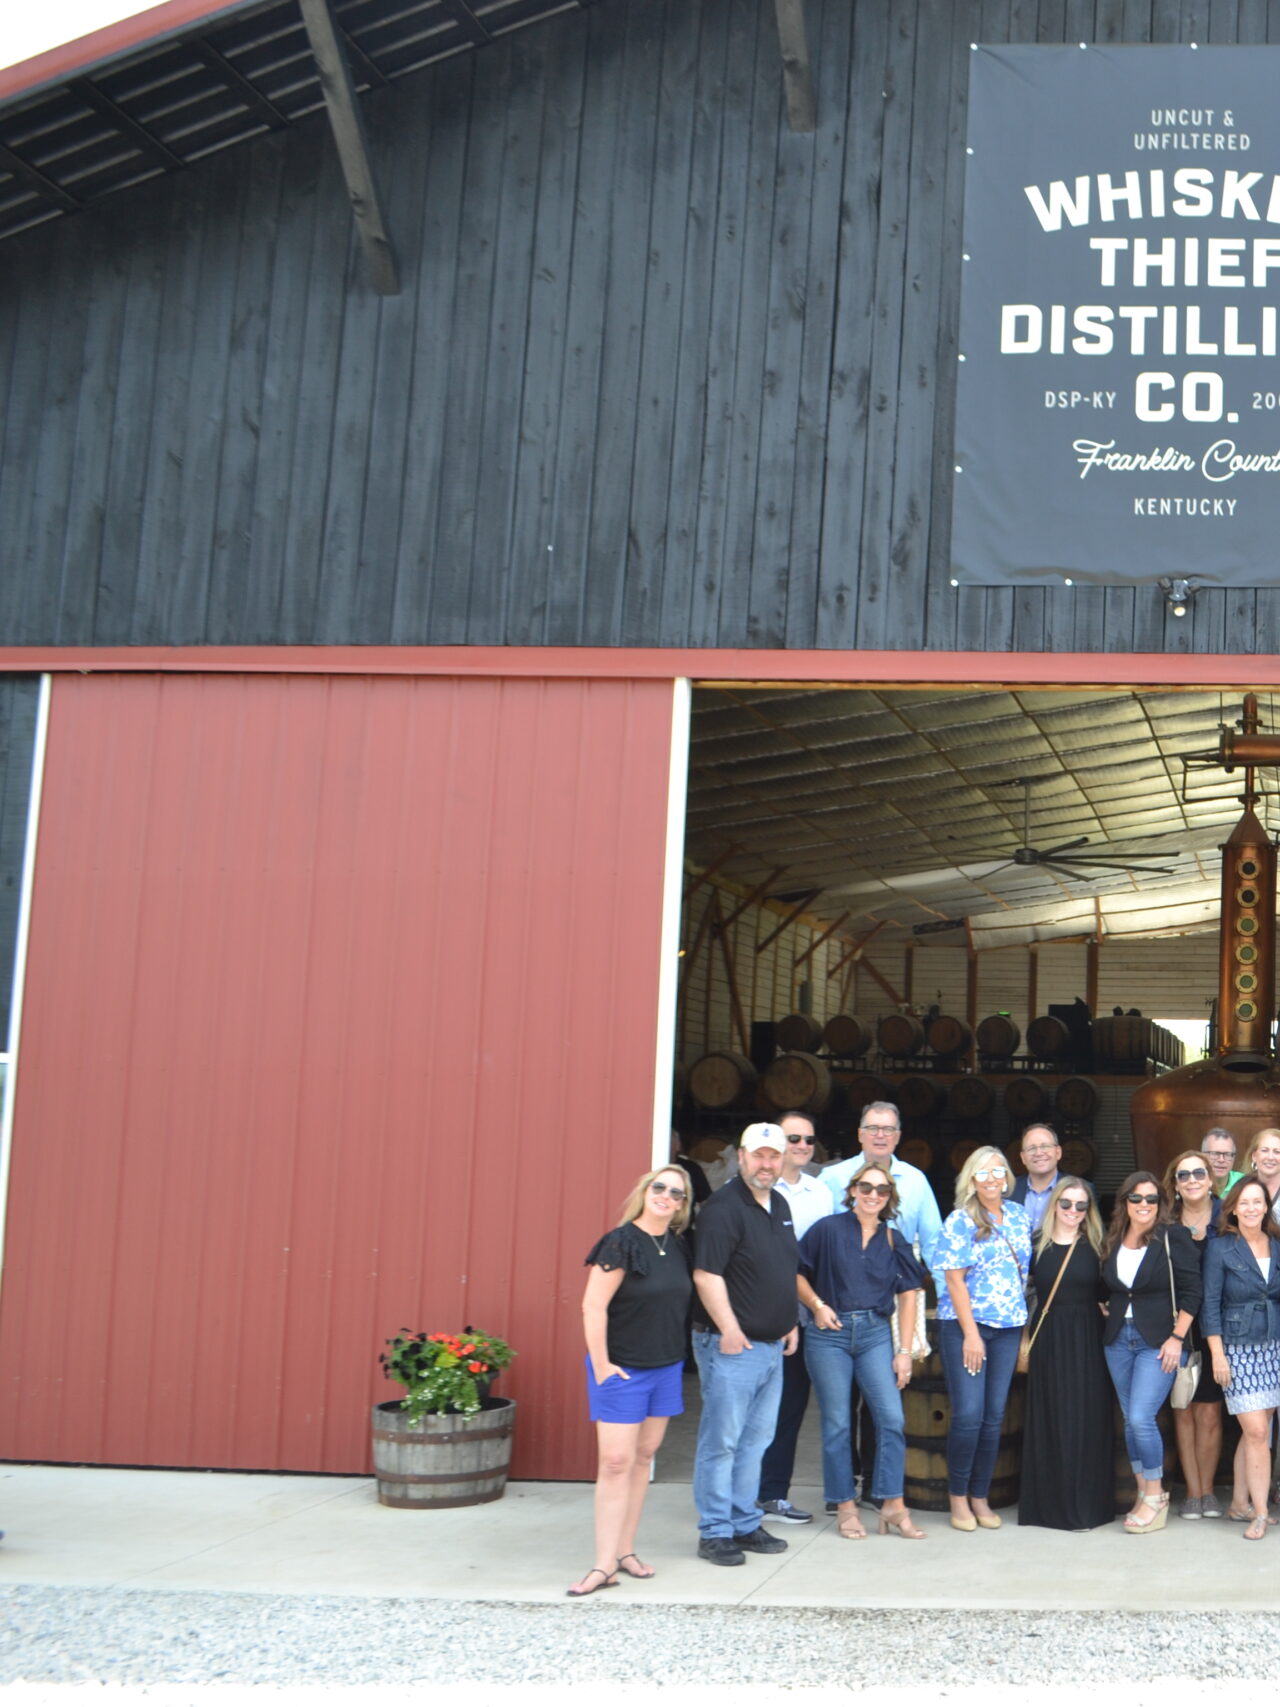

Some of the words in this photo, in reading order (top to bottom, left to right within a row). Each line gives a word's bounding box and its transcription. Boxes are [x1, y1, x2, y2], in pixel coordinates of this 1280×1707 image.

[1151, 109, 1215, 127] UNCUT
[1223, 109, 1235, 127] &
[1134, 132, 1251, 151] UNFILTERED
[1044, 390, 1117, 409] DSP-KY
[1135, 372, 1239, 423] CO.
[1073, 439, 1195, 479] Franklin
[1134, 497, 1237, 516] KENTUCKY
